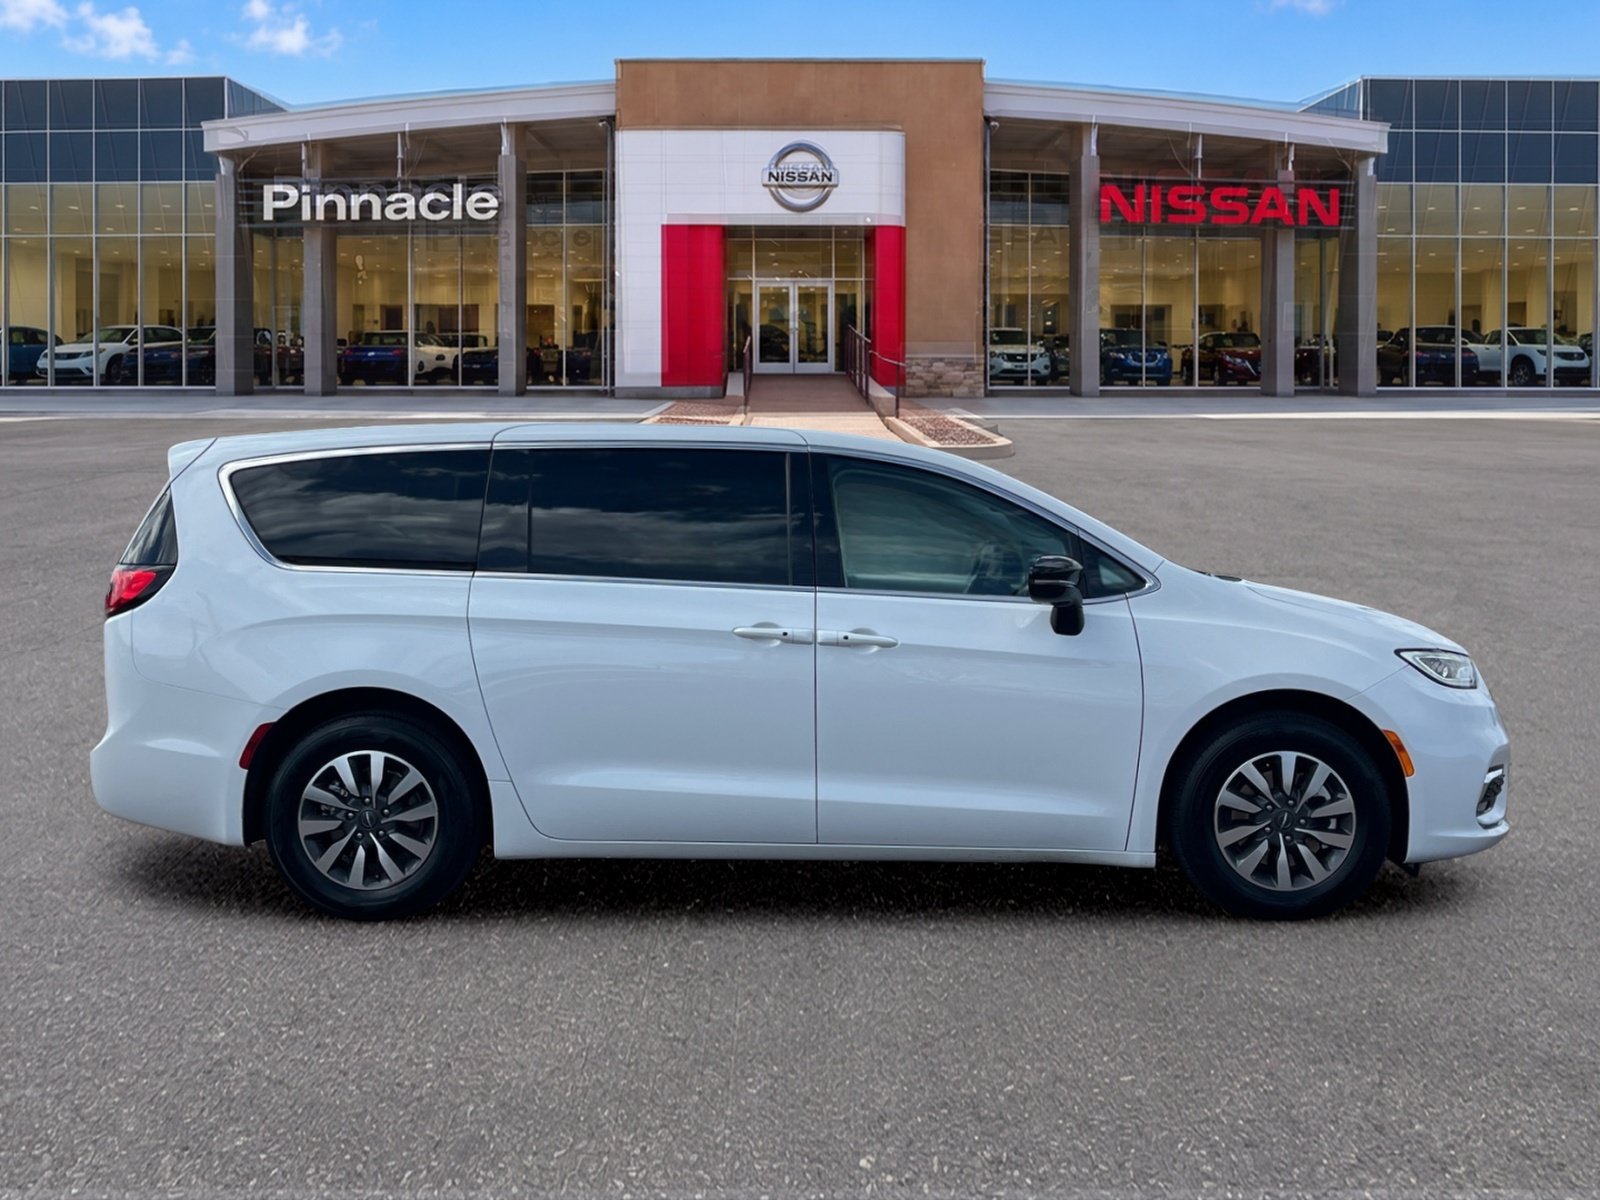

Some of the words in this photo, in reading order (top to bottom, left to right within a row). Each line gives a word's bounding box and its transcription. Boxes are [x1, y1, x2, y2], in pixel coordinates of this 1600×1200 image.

[767, 171, 833, 183] NISSAN
[262, 183, 499, 221] Pinnacle
[1099, 184, 1340, 226] NISSAN
